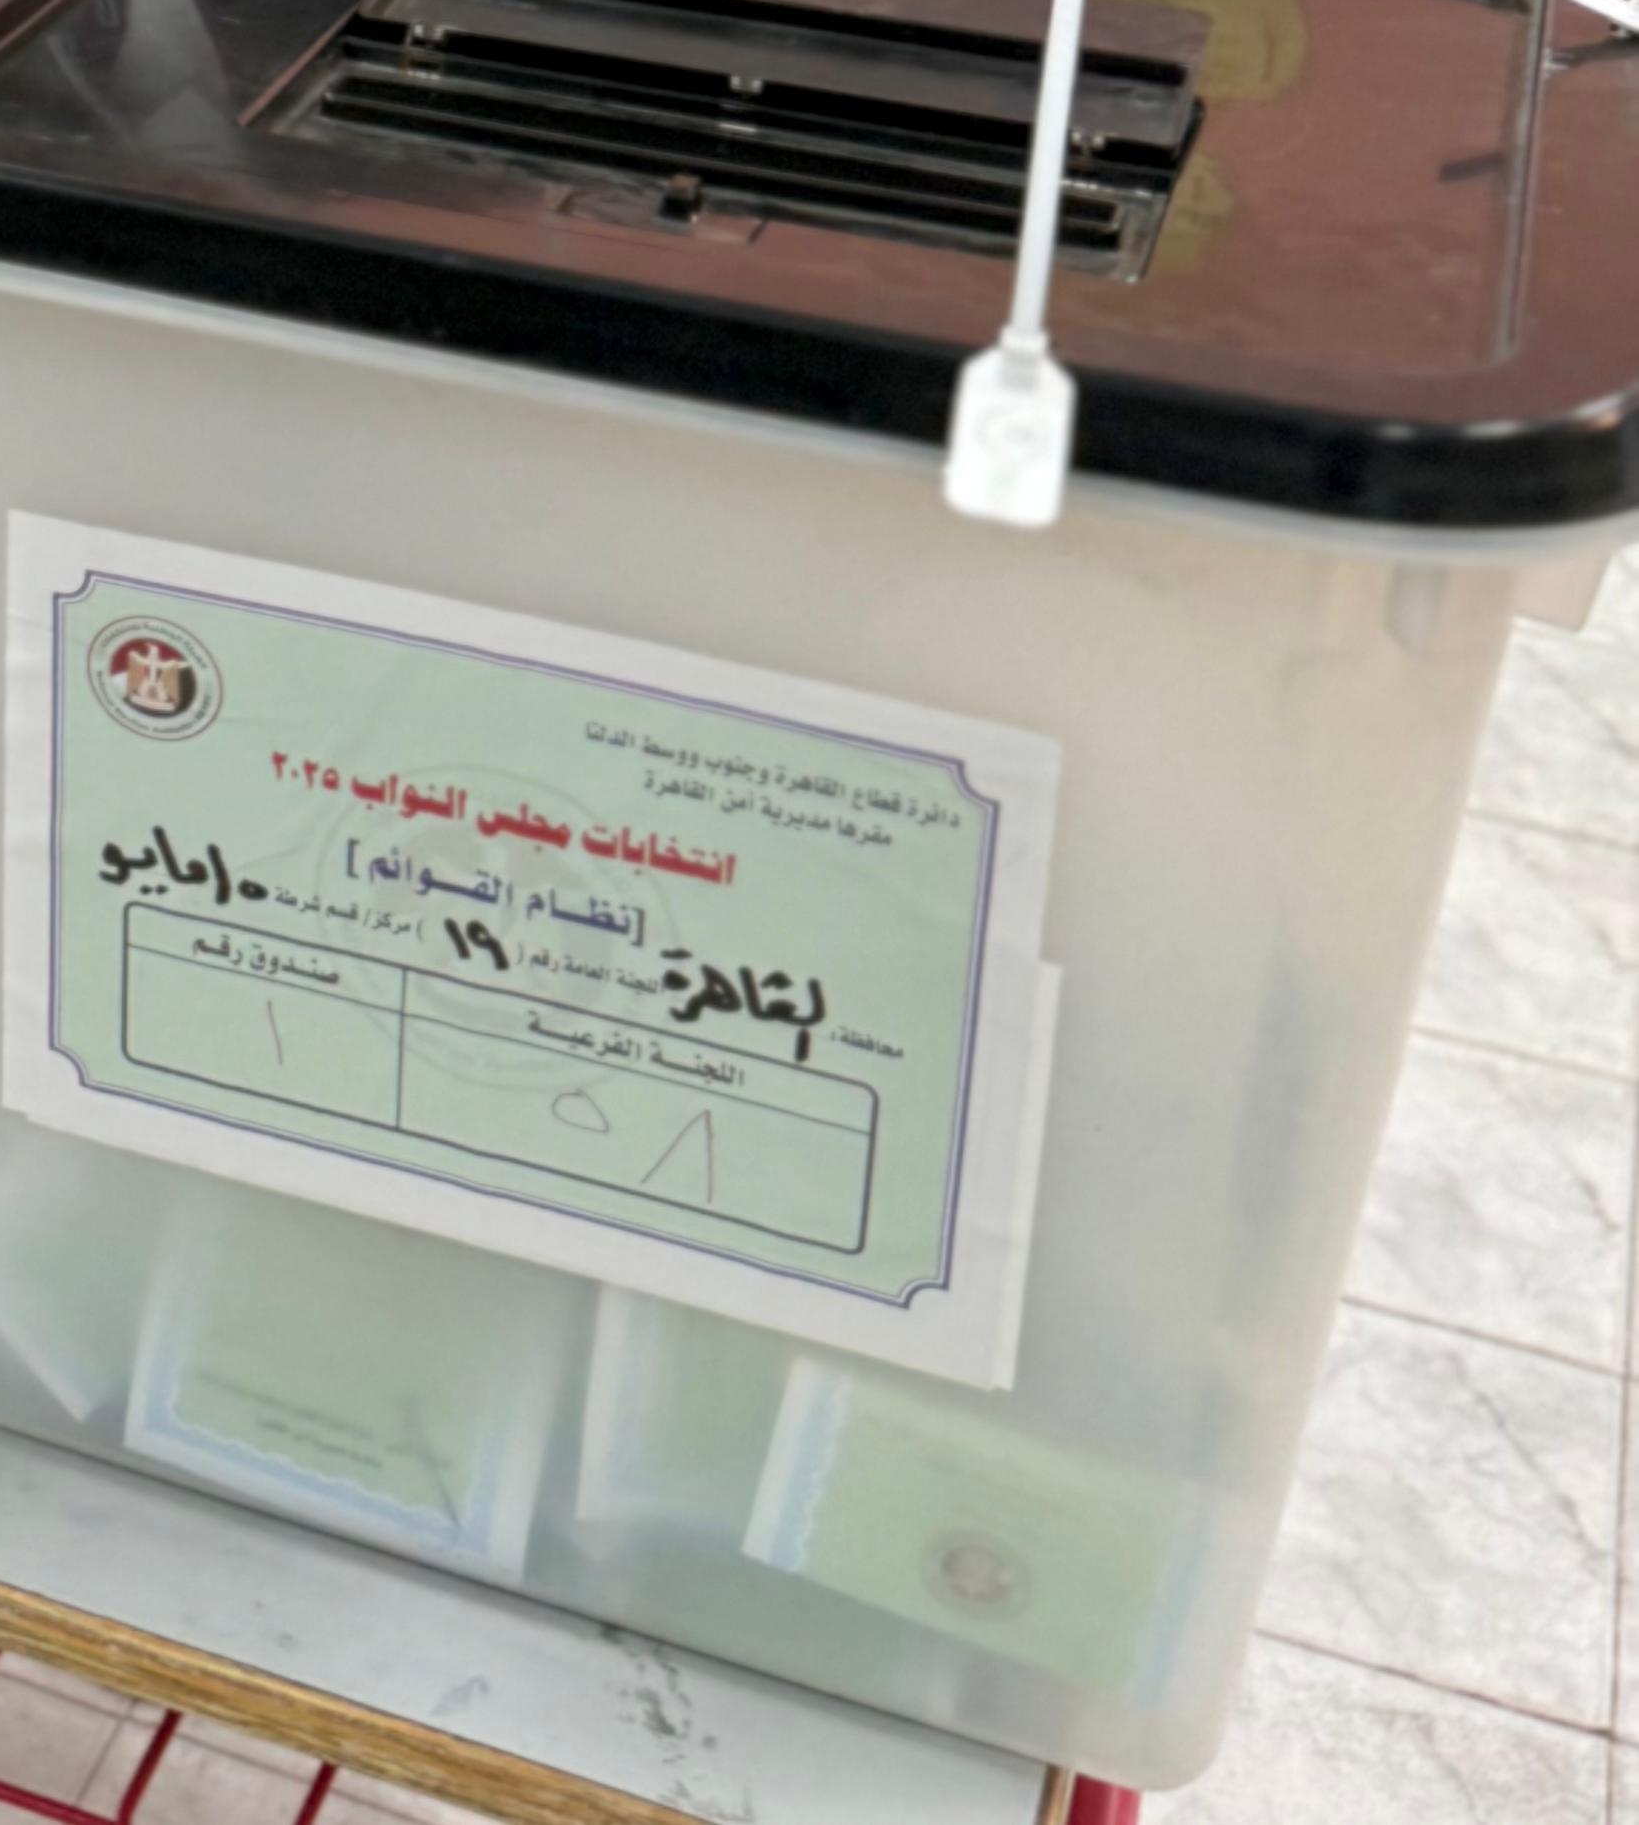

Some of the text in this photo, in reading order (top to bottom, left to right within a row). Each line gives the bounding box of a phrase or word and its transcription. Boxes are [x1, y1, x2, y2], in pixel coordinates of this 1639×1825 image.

[643, 768, 715, 804] القاهرة
[704, 754, 769, 785] وجنوب
[774, 766, 846, 801] القاهرة
[762, 800, 831, 833] مديرية
[851, 785, 902, 814] قطاع
[270, 751, 736, 885] انتخابات مجلس النواب ٢٠٢٥
[191, 932, 341, 986] صندوق رقم
[526, 1010, 746, 1086] اللجنة الفرعية
